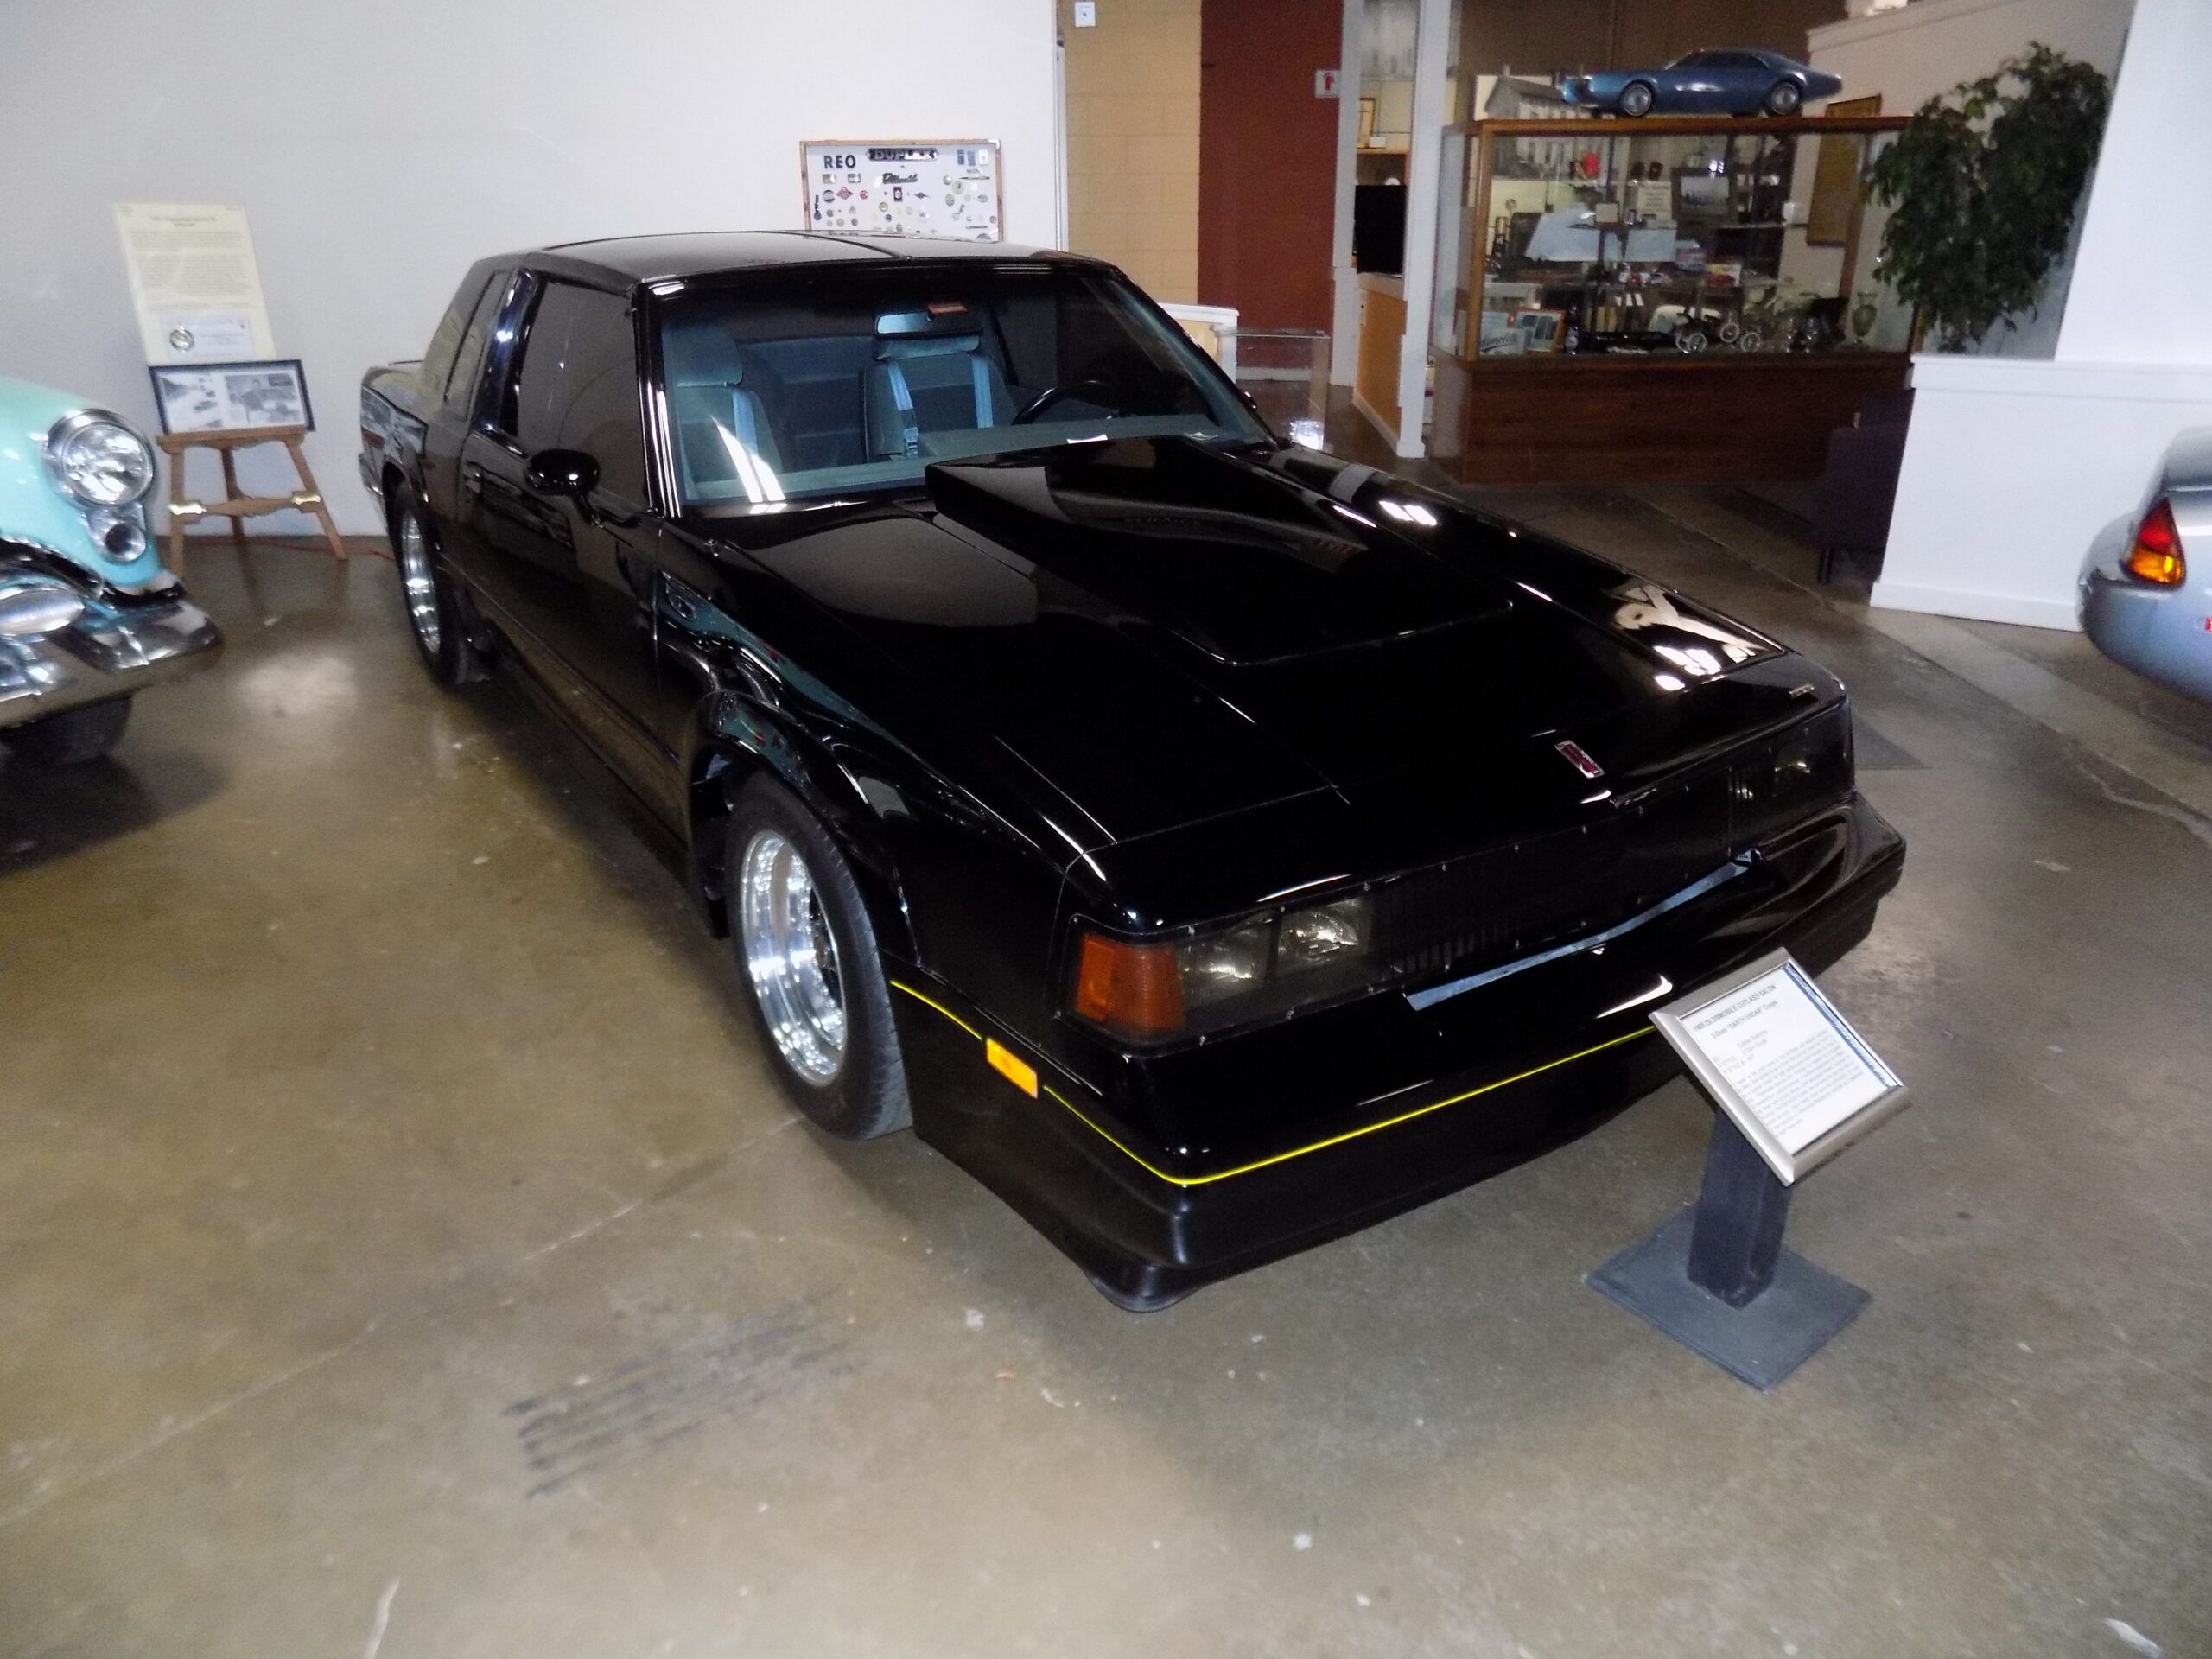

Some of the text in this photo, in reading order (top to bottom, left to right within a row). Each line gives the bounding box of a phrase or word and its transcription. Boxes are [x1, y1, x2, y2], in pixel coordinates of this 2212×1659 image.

[823, 155, 856, 169] REO
[1704, 1005, 1738, 1026] OLDSMOBILE
[1737, 993, 1760, 1008] CUTLASS
[1759, 984, 1777, 996] SALON
